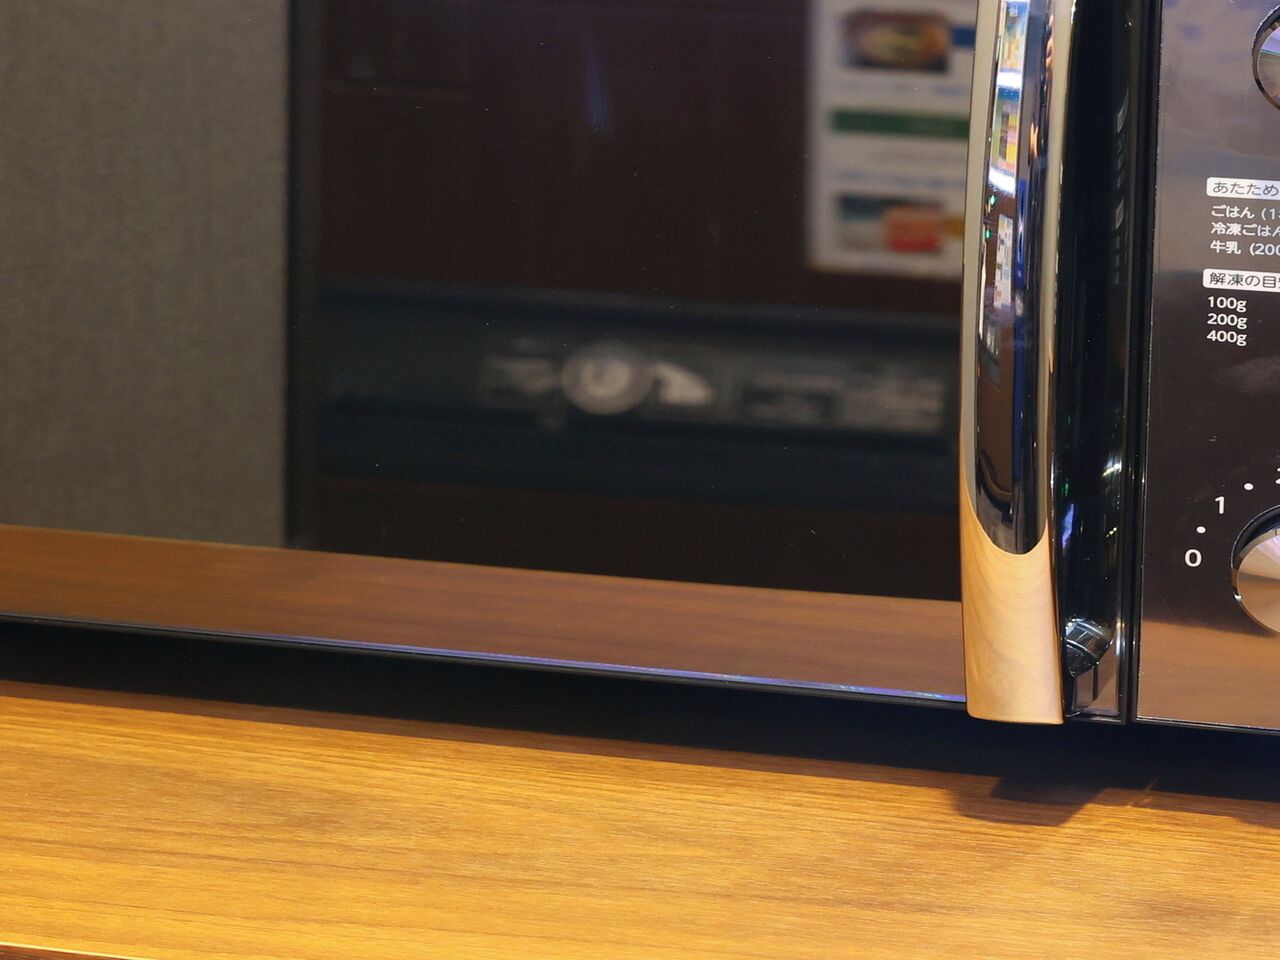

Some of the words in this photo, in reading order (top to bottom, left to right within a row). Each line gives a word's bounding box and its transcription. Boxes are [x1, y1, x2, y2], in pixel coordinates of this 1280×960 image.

[1212, 205, 1254, 218] ごはん
[1211, 240, 1241, 254] 牛乳
[1208, 297, 1246, 312] 100g
[1208, 313, 1247, 329] 200g
[1207, 330, 1247, 346] 400g
[1215, 497, 1224, 514] 1
[1185, 549, 1201, 566] 0
